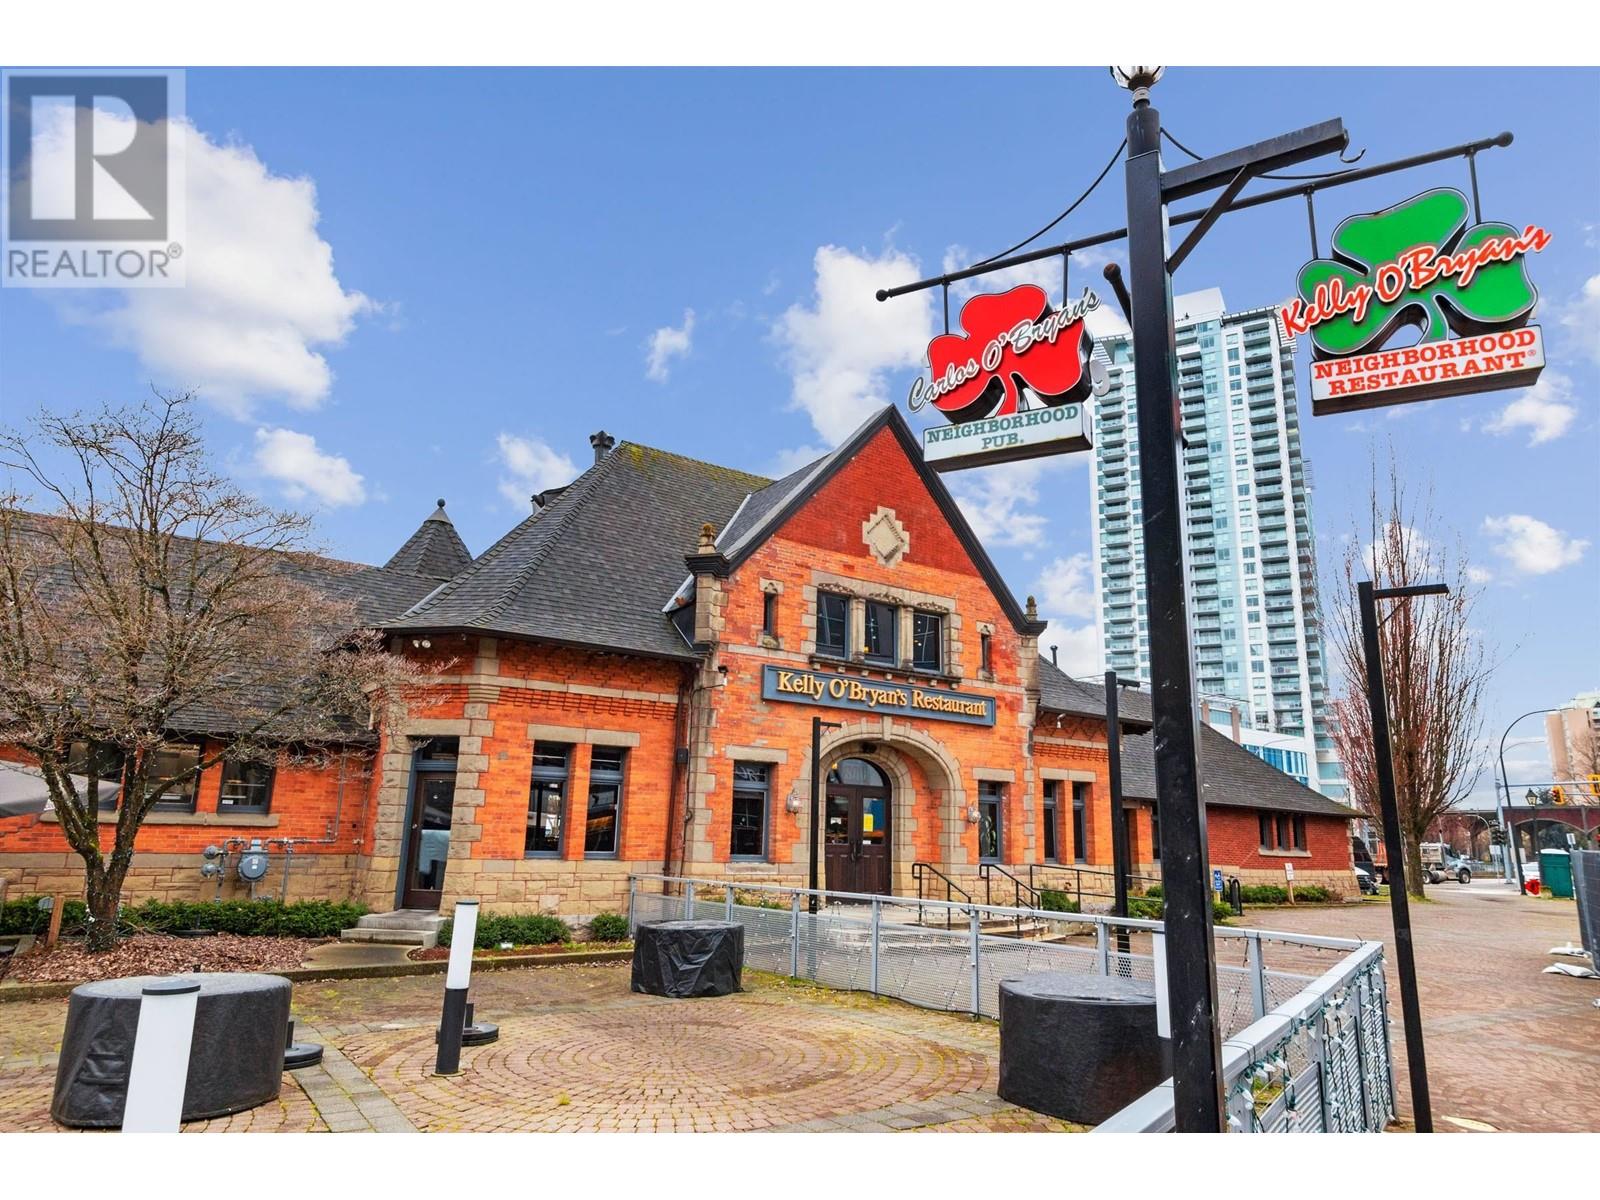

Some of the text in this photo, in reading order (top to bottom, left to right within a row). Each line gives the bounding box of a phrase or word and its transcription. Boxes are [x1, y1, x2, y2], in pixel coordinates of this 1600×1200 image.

[1280, 225, 1551, 340] Kelly O'Bryan's
[908, 286, 1101, 412] Carlos O'Bryan's
[1314, 330, 1536, 379] NEIGHBORHOOD
[927, 406, 1078, 443] NEIGHBORHOOD
[981, 433, 1024, 449] PUB.
[777, 671, 987, 716] Kelly O'Bryan's Restaurant
